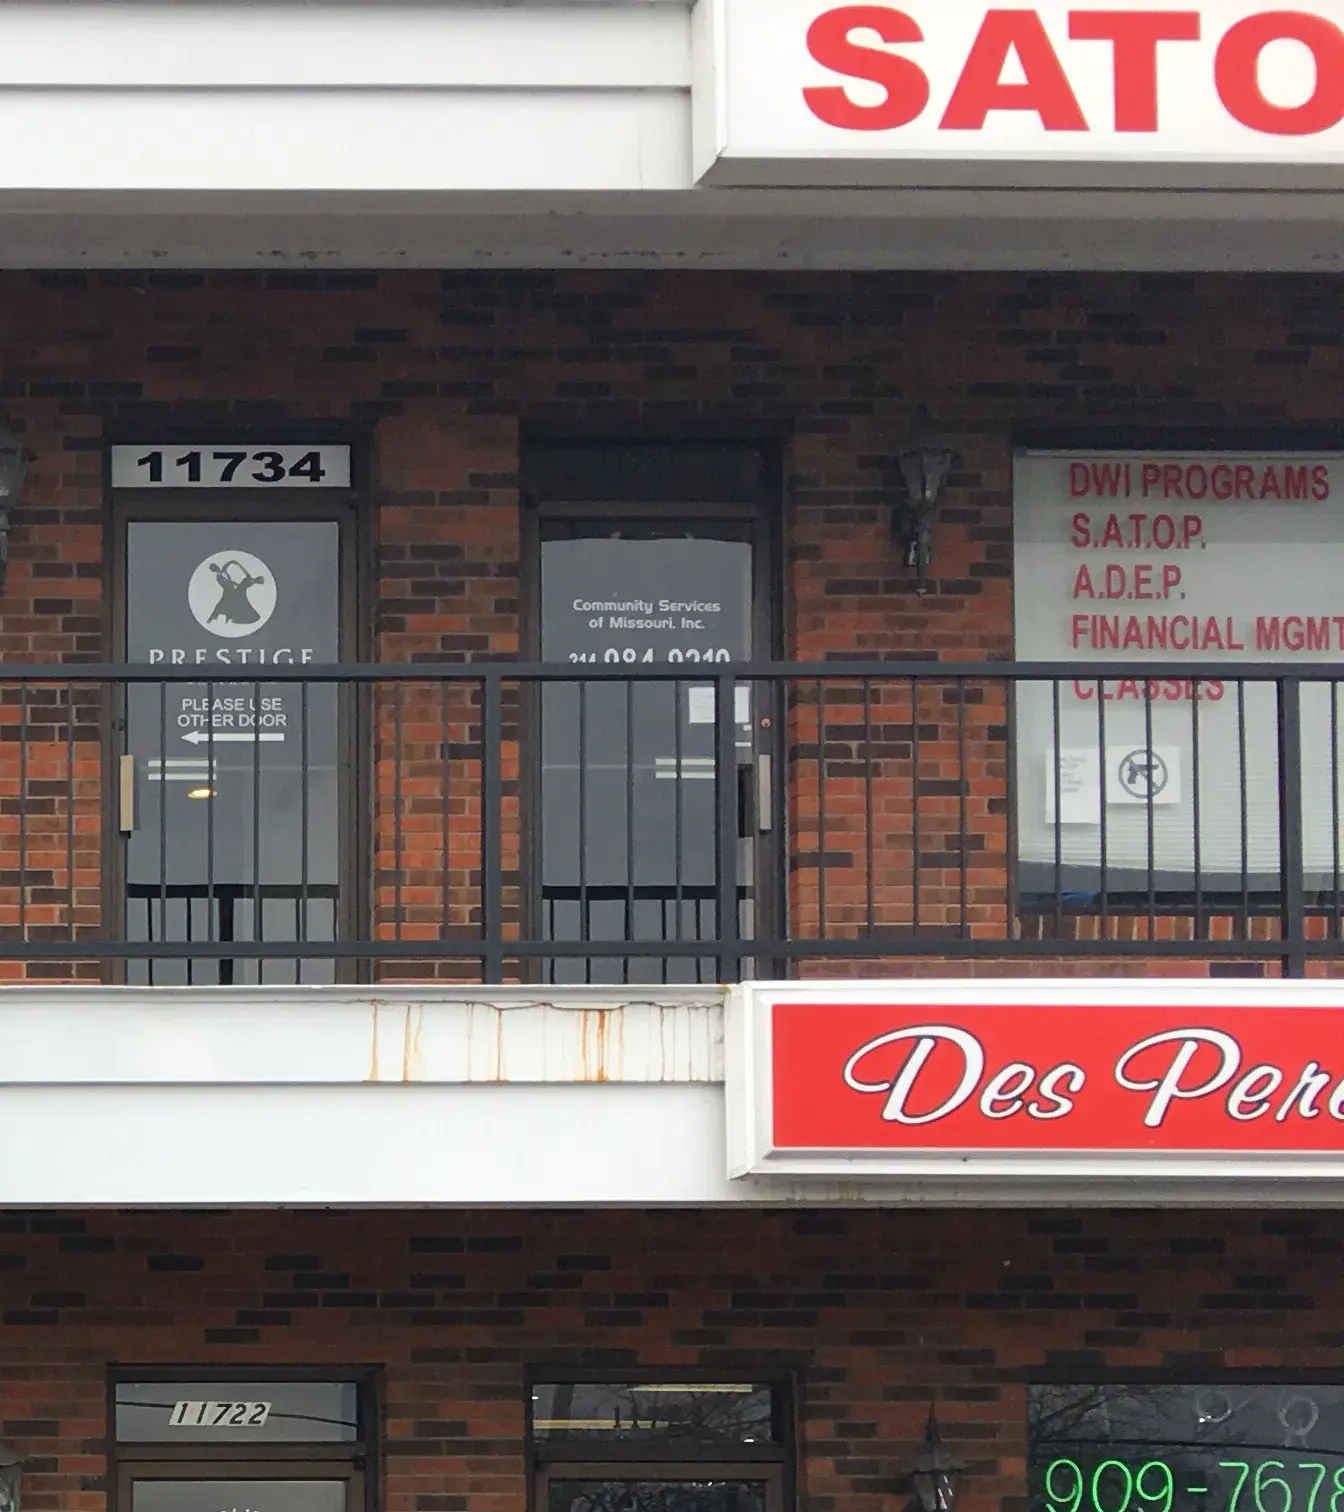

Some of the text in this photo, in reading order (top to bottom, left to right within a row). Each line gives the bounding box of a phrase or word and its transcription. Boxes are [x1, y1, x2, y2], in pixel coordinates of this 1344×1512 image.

[803, 4, 1344, 136] SATO
[136, 451, 326, 482] 11734
[1070, 462, 1330, 502] DWI PROGRAMS
[1071, 515, 1207, 550] S.A.T.O.P.
[1073, 565, 1186, 600] A.D.E.P.
[572, 599, 721, 614] Community Services
[588, 616, 603, 629] of
[681, 617, 706, 629] Inc.
[1072, 615, 1244, 651] FINANCIAL
[177, 714, 287, 727] OTHER DOOR
[182, 698, 282, 711] PLEASE USE
[842, 1024, 1086, 1126] Des
[176, 1402, 269, 1426] 11722
